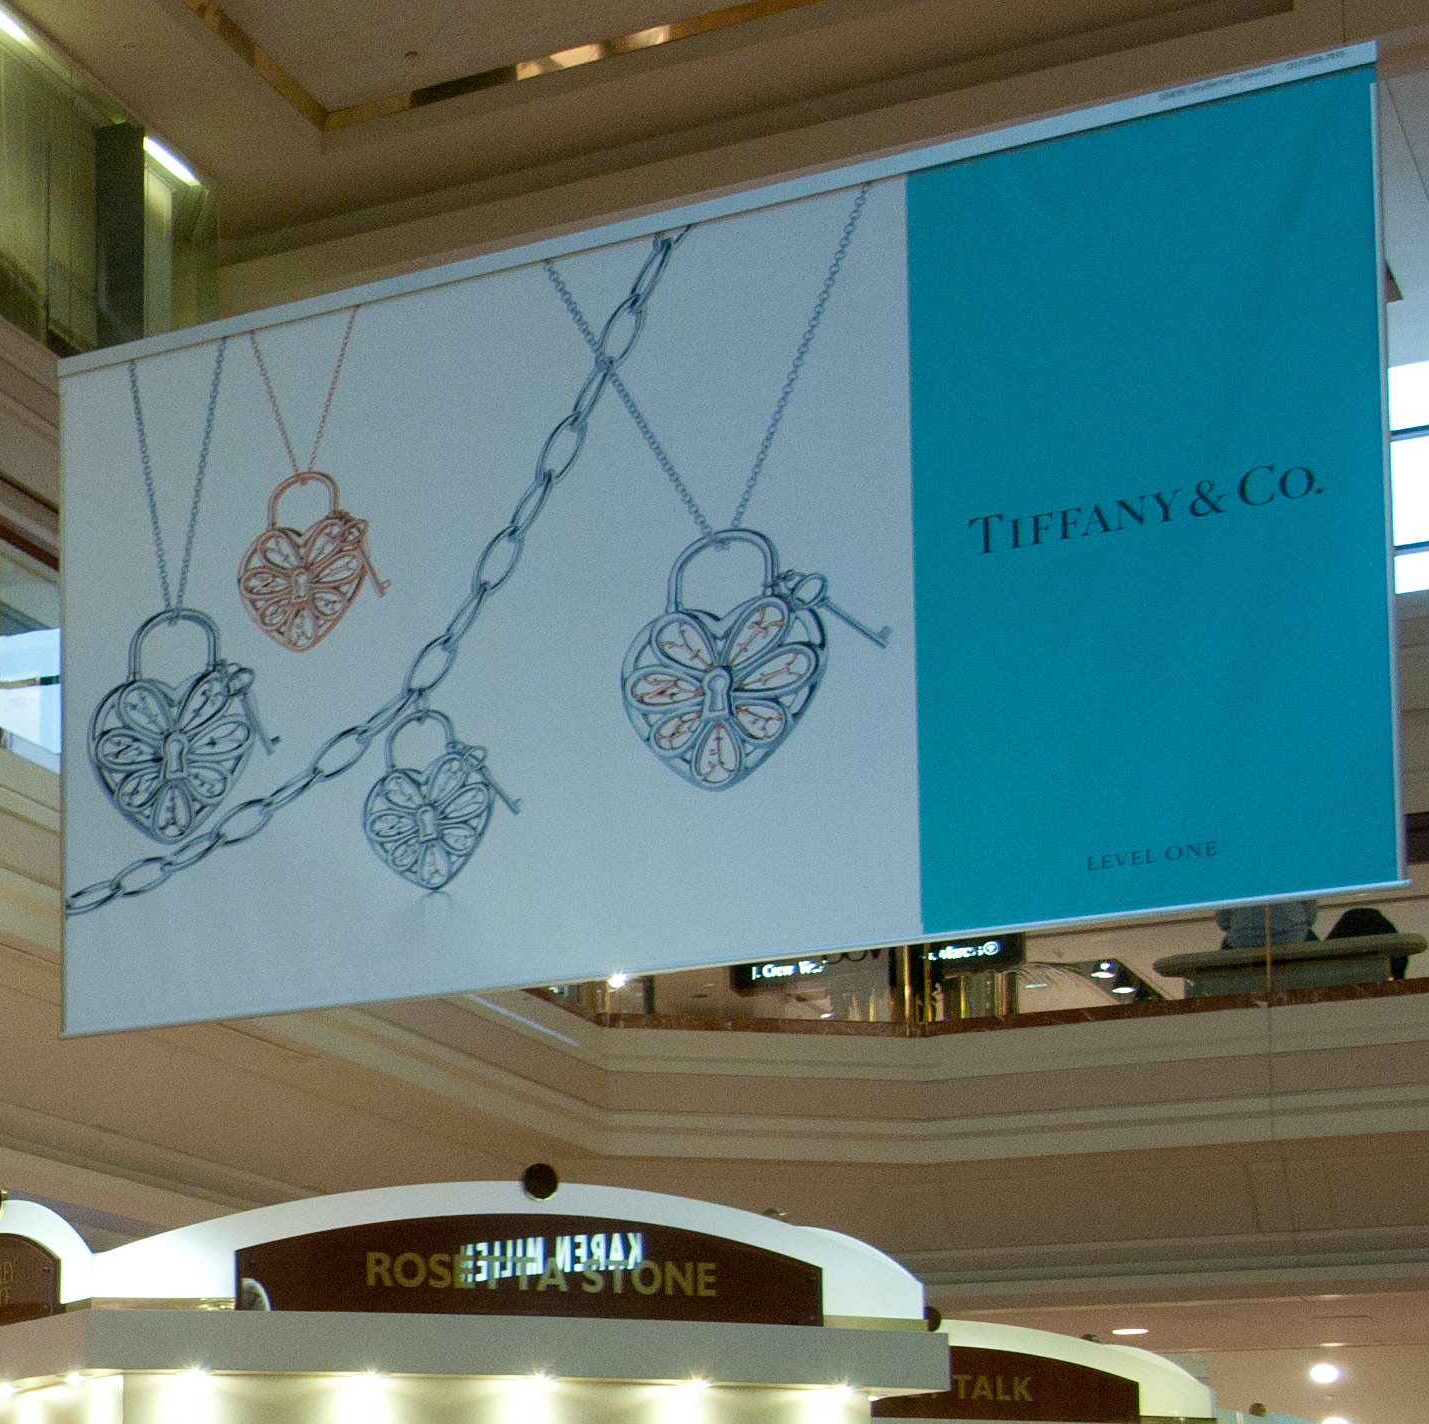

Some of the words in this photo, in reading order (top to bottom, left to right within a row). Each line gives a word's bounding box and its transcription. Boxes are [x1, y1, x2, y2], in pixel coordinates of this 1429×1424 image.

[968, 488, 1182, 555] TIFFANY
[1188, 479, 1226, 518] &
[1086, 849, 1157, 872] LEVEL
[1164, 841, 1218, 861] ONE
[366, 1251, 569, 1293] ROSETTA
[581, 1260, 718, 1297] STONE
[952, 1374, 1033, 1401] TALK
